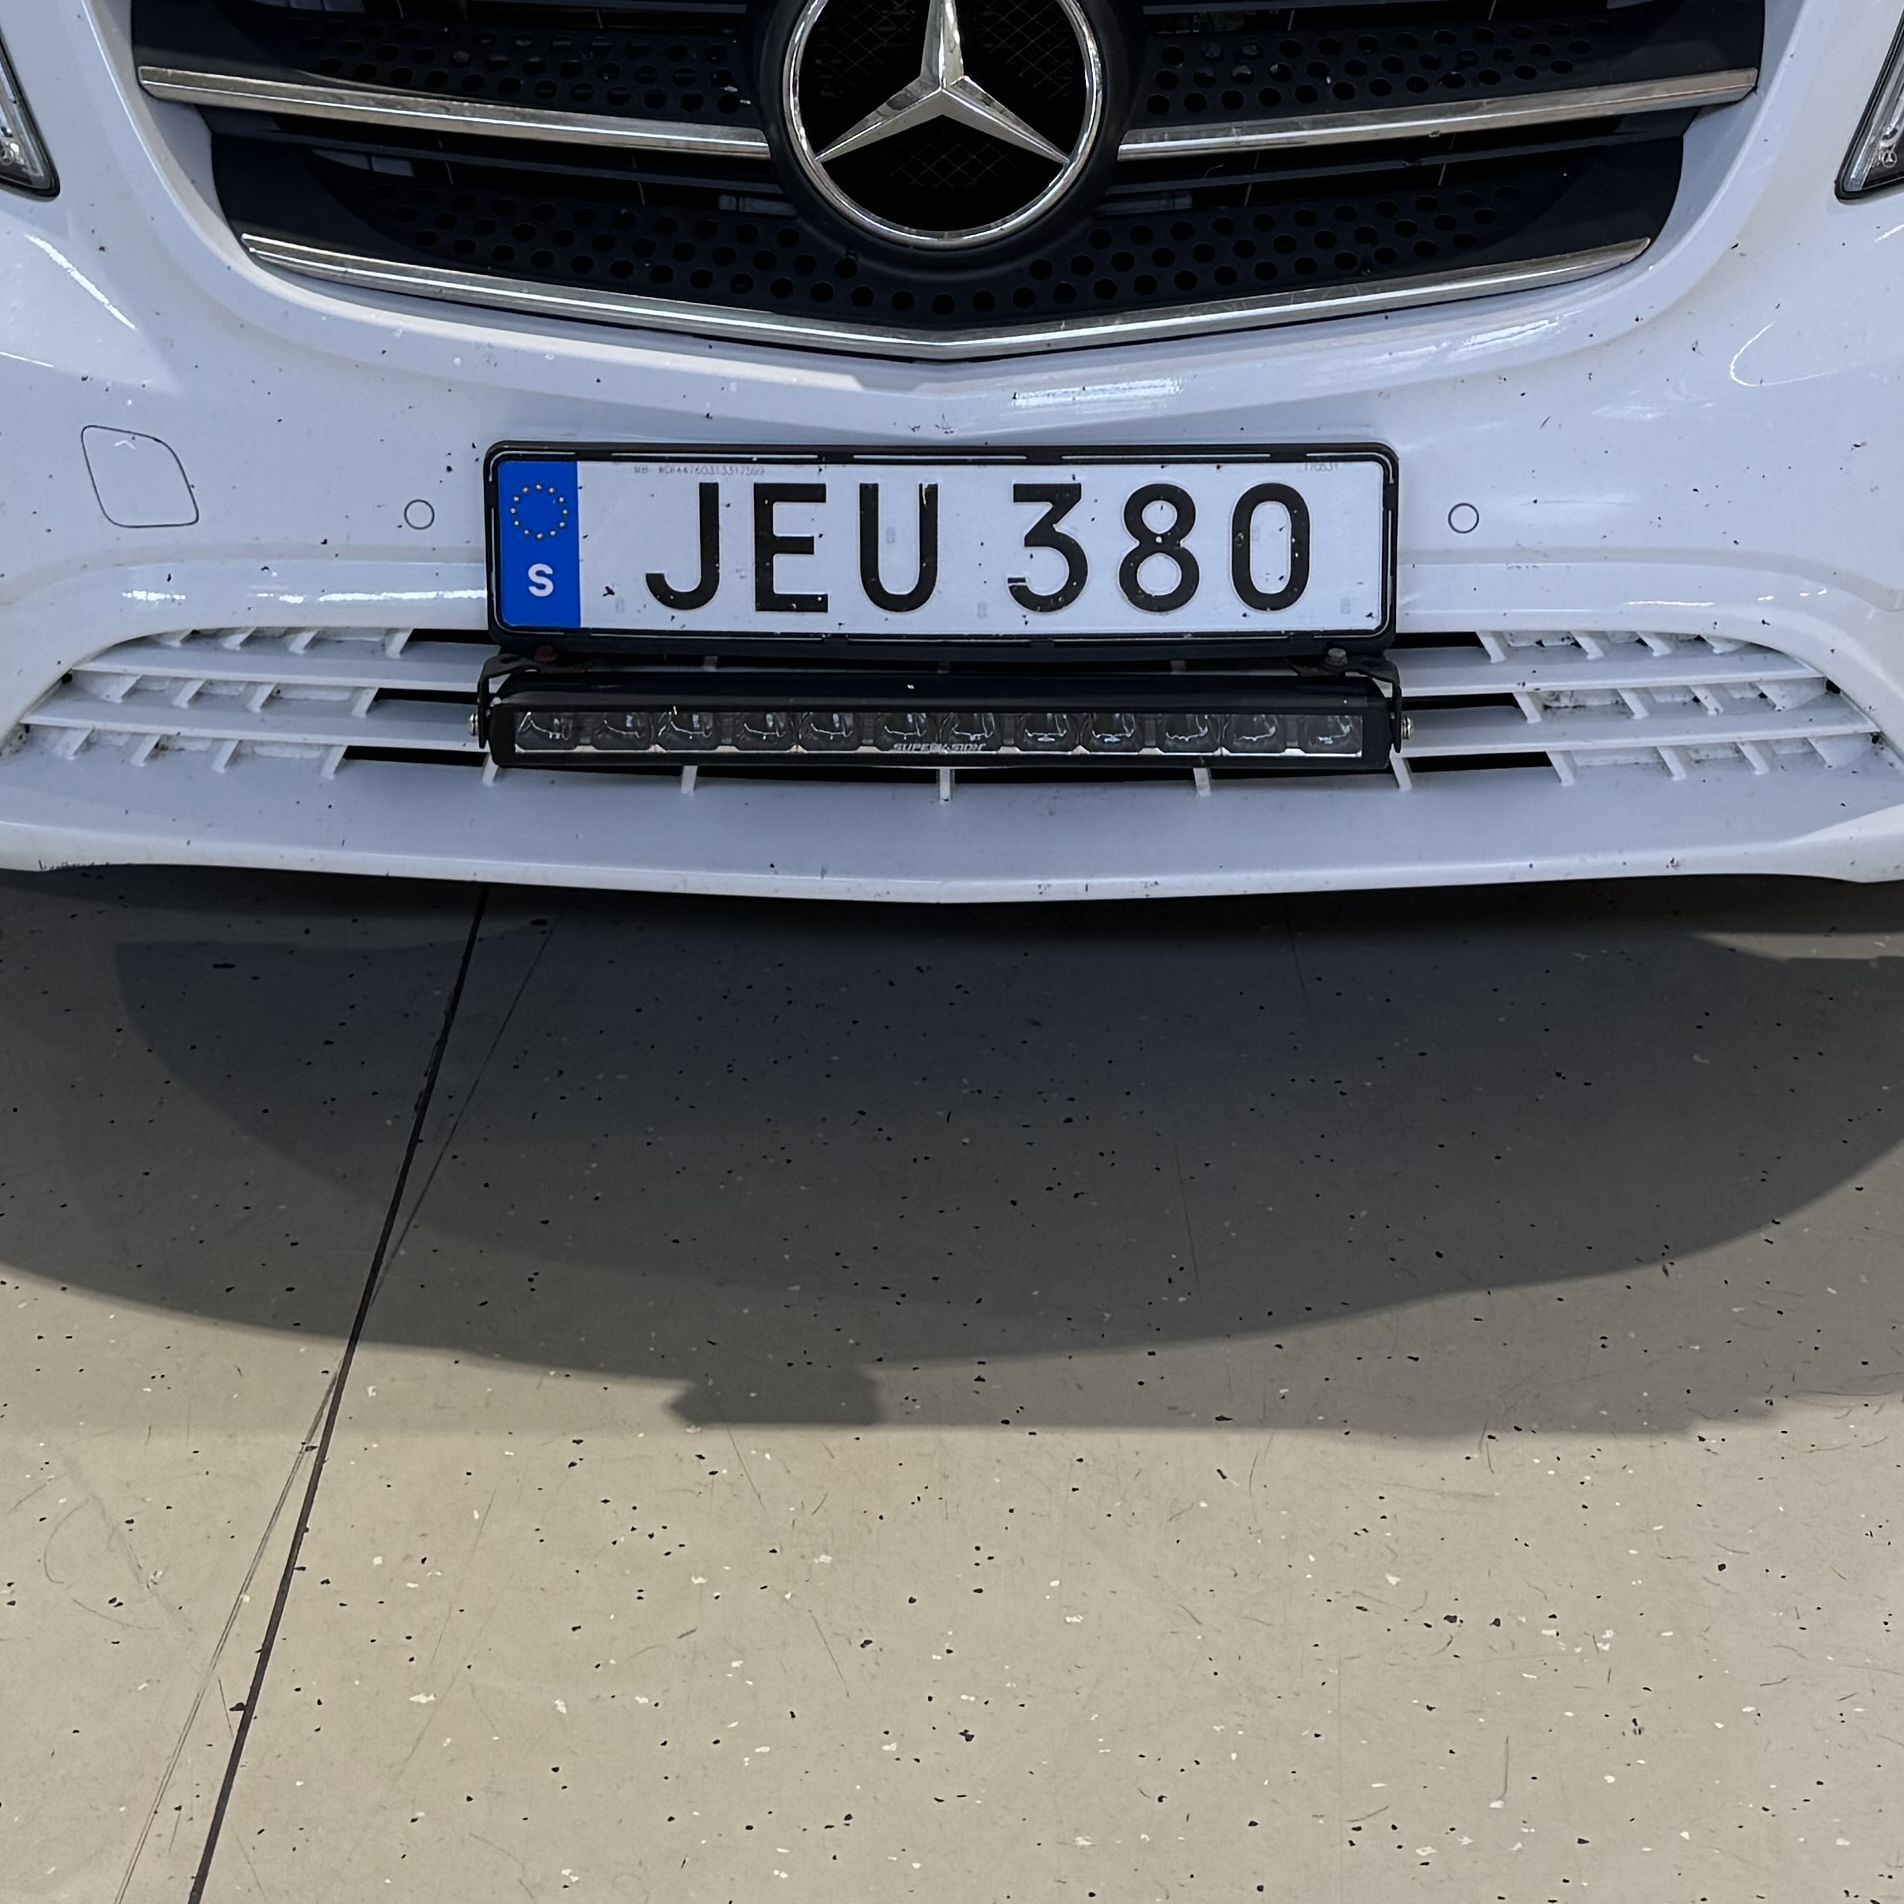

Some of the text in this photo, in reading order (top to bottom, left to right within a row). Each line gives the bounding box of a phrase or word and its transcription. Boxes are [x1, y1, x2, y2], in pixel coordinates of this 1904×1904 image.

[528, 563, 554, 597] S
[645, 482, 1313, 614] JEU 380
